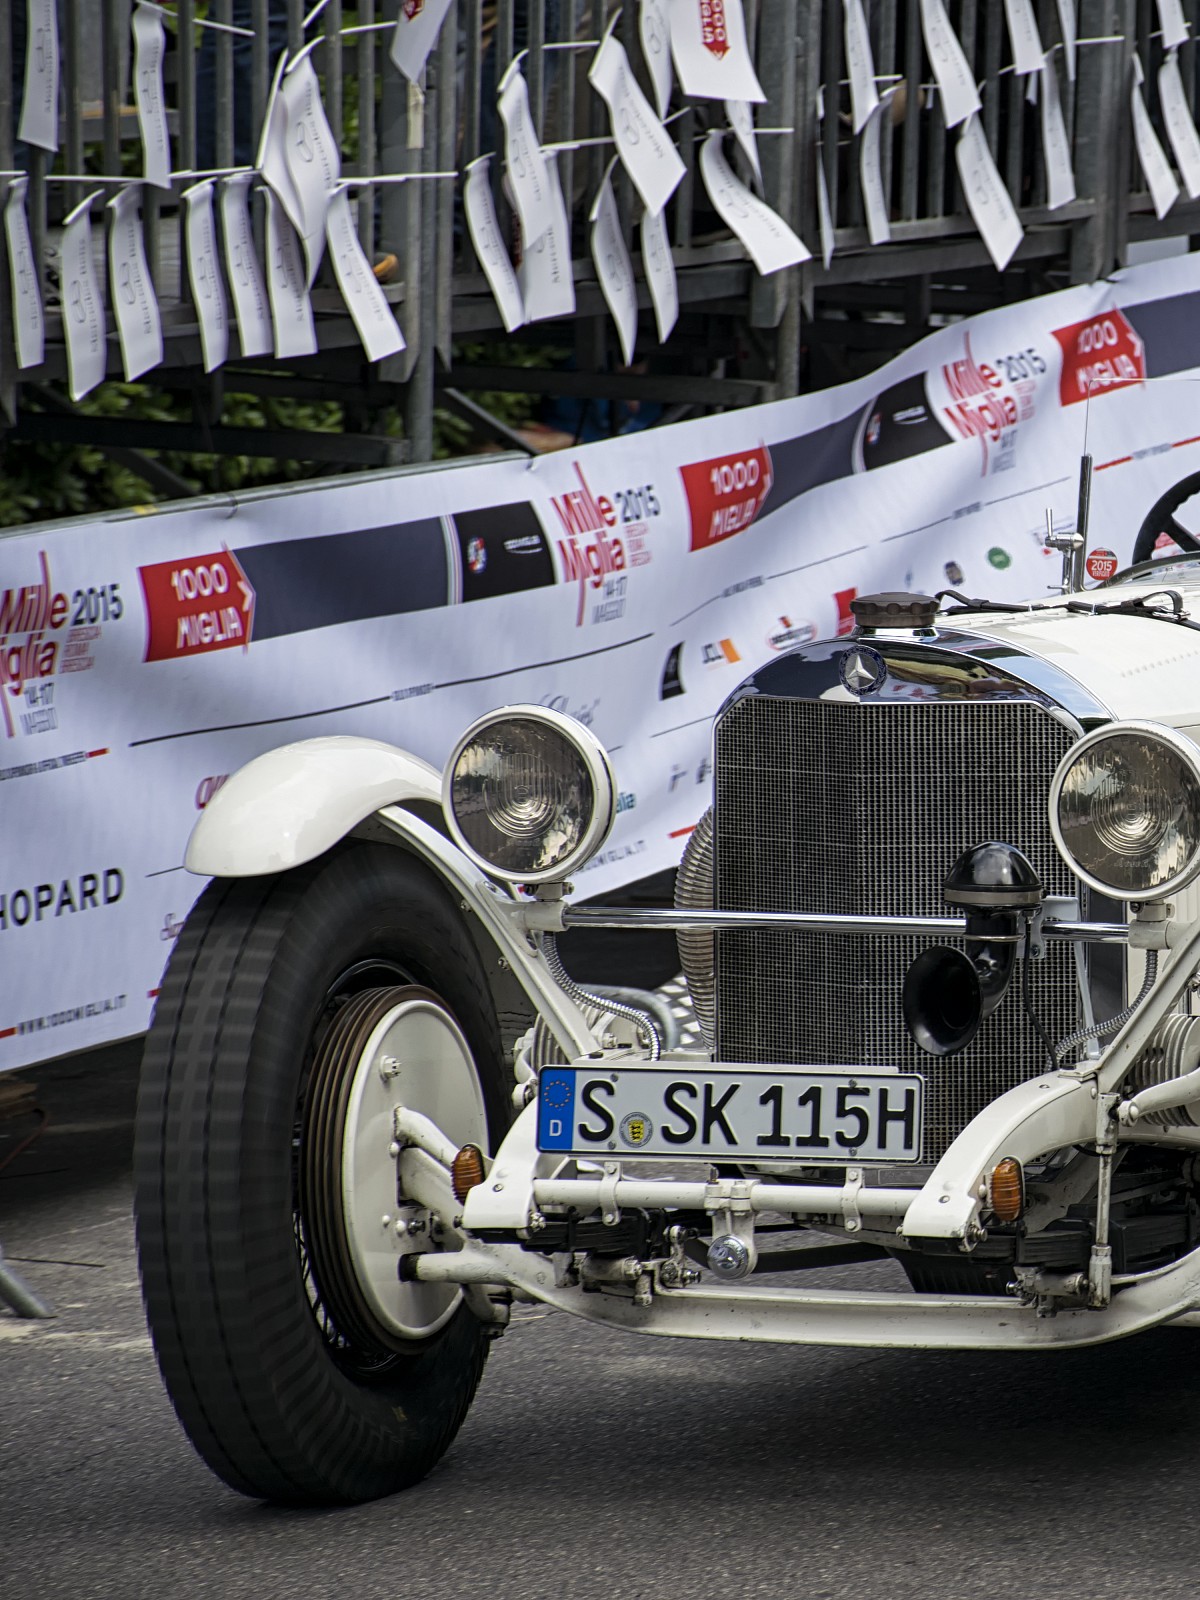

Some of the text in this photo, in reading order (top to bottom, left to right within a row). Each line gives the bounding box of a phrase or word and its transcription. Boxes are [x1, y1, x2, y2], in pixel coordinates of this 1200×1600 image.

[1077, 321, 1118, 355] 1000
[943, 331, 1002, 401] Mille
[996, 349, 1047, 382] 2015
[1075, 354, 1139, 394] MIGLIA
[943, 391, 1017, 477] Miglia
[550, 461, 661, 536] Mille 2015
[710, 458, 759, 496] 1000
[708, 497, 756, 539] MIGLIA
[171, 562, 229, 602] 1000
[556, 530, 626, 627] Miglia
[1091, 560, 1113, 572] 2015
[0, 550, 124, 634] Mille 2015
[176, 606, 244, 649] MIGLIA
[0, 632, 59, 738] iglia
[549, 1120, 563, 1137] D
[578, 1080, 616, 1142] S
[661, 1082, 741, 1145] SK
[757, 1084, 915, 1150] 115H
